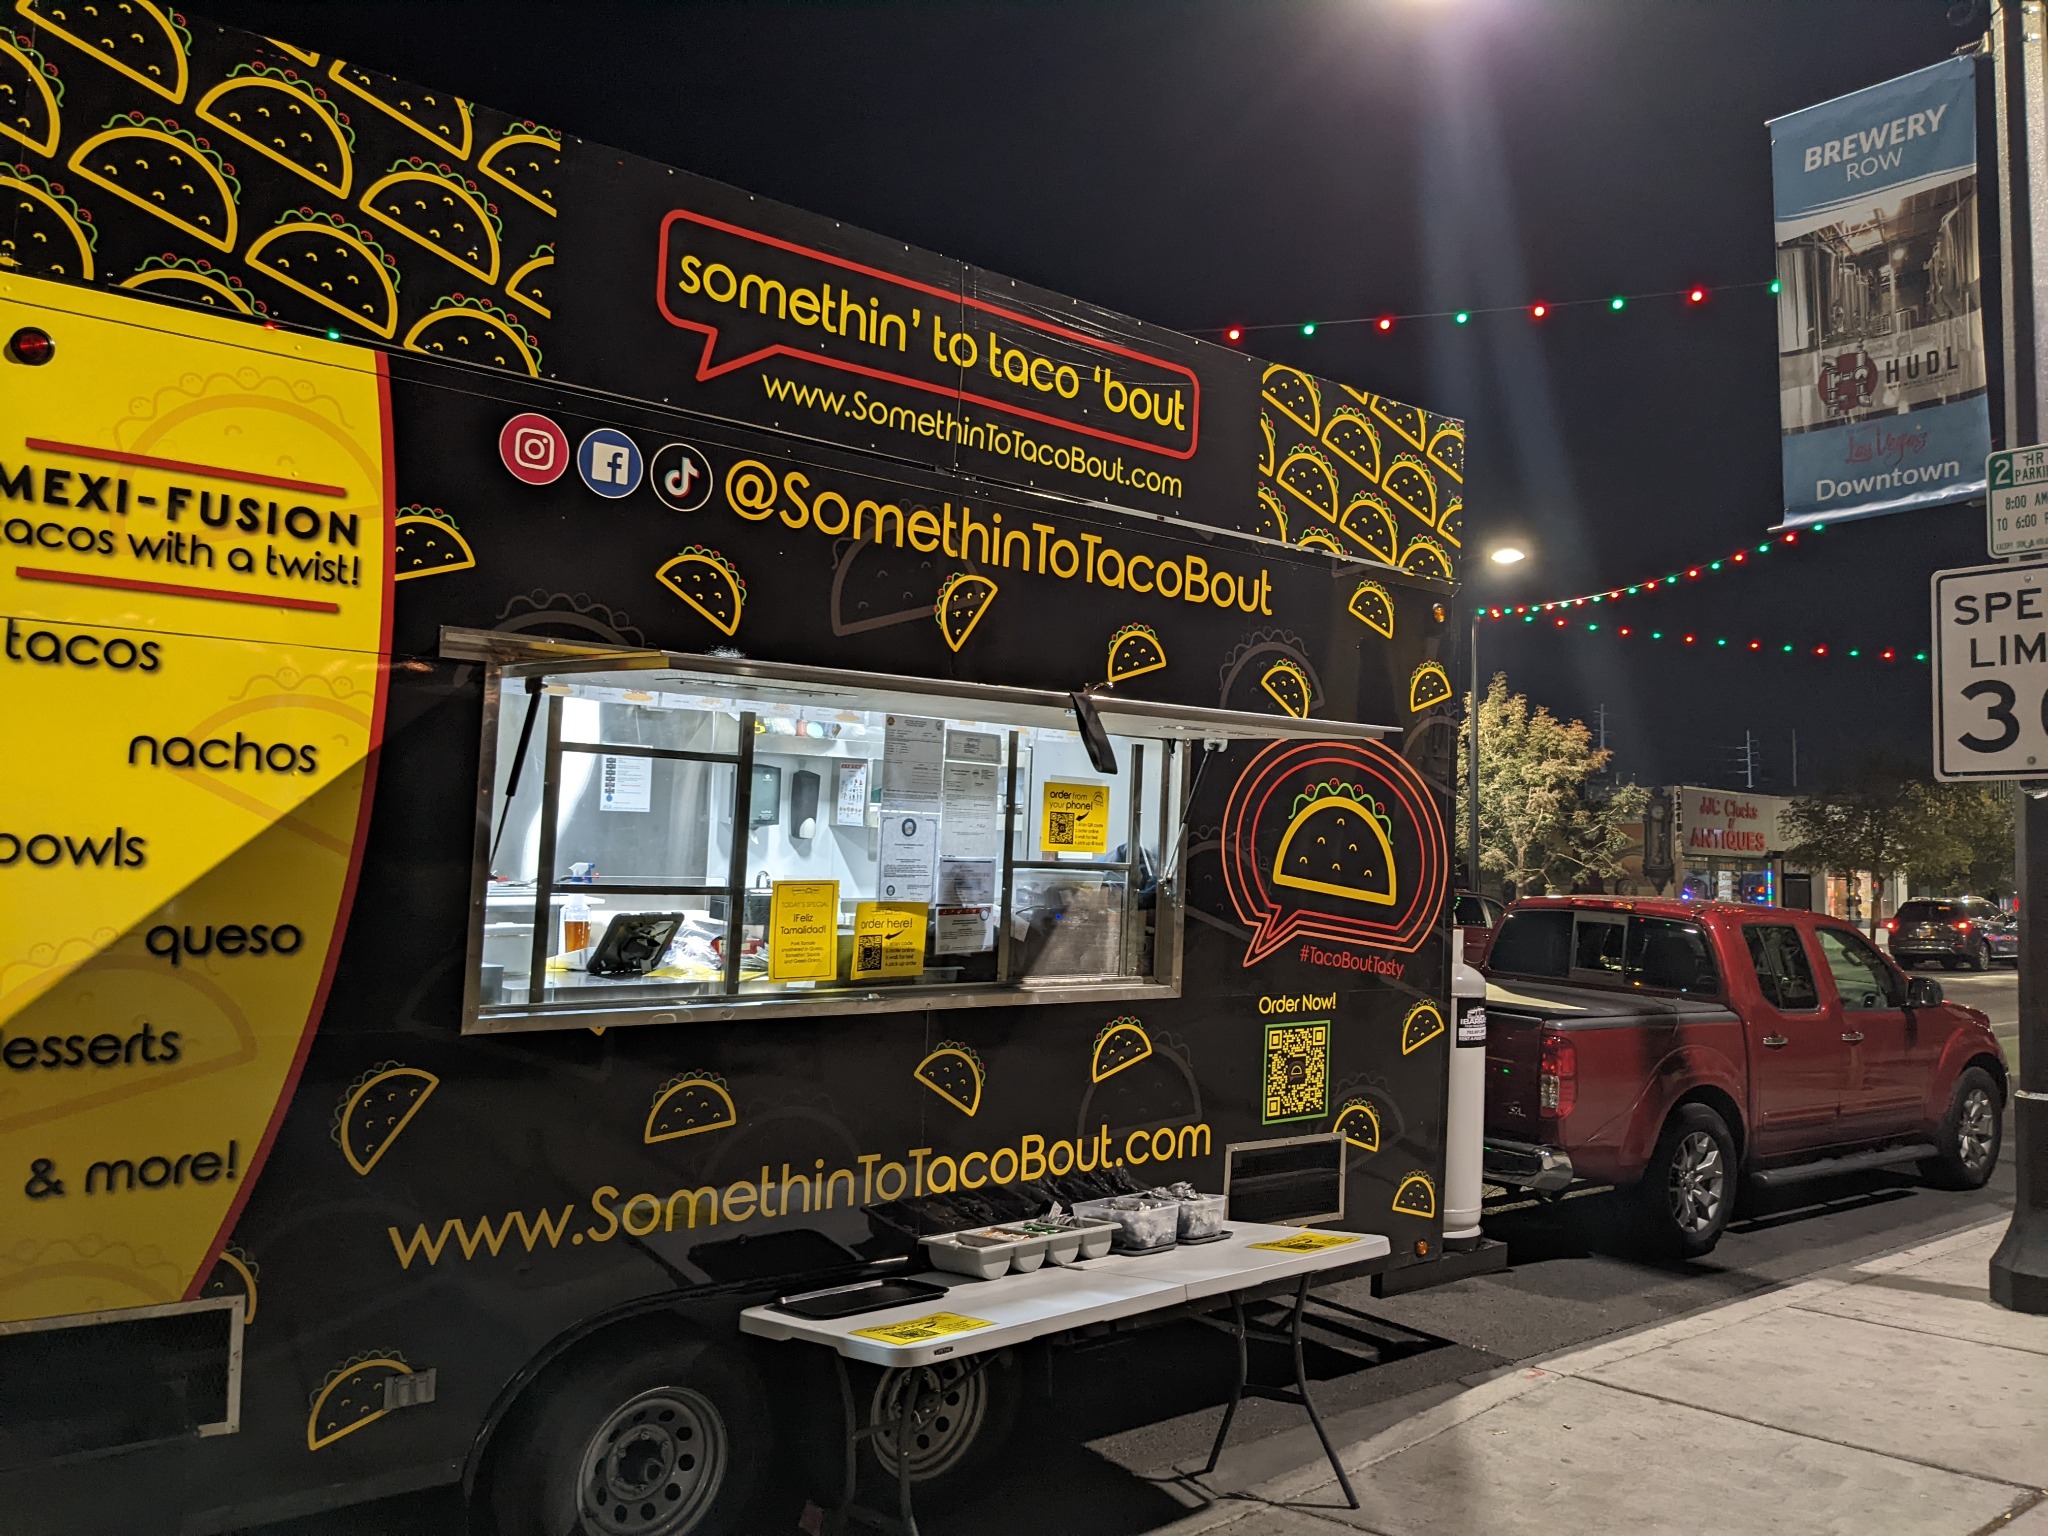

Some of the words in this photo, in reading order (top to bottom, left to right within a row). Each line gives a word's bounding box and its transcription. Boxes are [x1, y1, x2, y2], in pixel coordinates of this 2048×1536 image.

[1803, 103, 1948, 173] BREWERY
[1845, 147, 1904, 182] ROW
[678, 254, 921, 352] somethin'
[933, 315, 978, 368] to
[989, 331, 1080, 399] taco
[1885, 347, 1959, 384] HUDL
[761, 373, 1183, 498] www.SomethinToTacoBout.com
[1816, 460, 1961, 501] Downtown
[1994, 458, 2012, 486] 2
[2025, 451, 2044, 467] HR
[2014, 465, 2048, 483] PARKI
[0, 464, 360, 548] MEXI-FUSION
[1996, 517, 2008, 532] TO
[2015, 513, 2037, 530] 6:00
[2005, 494, 2027, 511] 8:00
[0, 517, 114, 555] acos
[127, 530, 215, 568] with
[227, 547, 254, 574] a
[266, 544, 362, 586] twist!
[725, 459, 1273, 616] @SomethinToTacoBout
[5, 618, 162, 672] tacos
[1957, 679, 2048, 754] 3
[127, 731, 319, 774] nachos
[1049, 789, 1072, 800] order
[1690, 827, 1765, 852] ANTIQUES
[145, 923, 304, 966] queso
[860, 918, 885, 930] order
[886, 917, 913, 929] here!
[1299, 945, 1405, 981] #TacoBoutTasty
[1258, 994, 1300, 1016] Order
[1302, 992, 1337, 1012] Now!
[0, 1022, 182, 1071] esserts
[24, 1158, 66, 1199] &
[84, 1139, 239, 1194] more!
[388, 1121, 1212, 1271] www.SomethinToTacoBout.com
